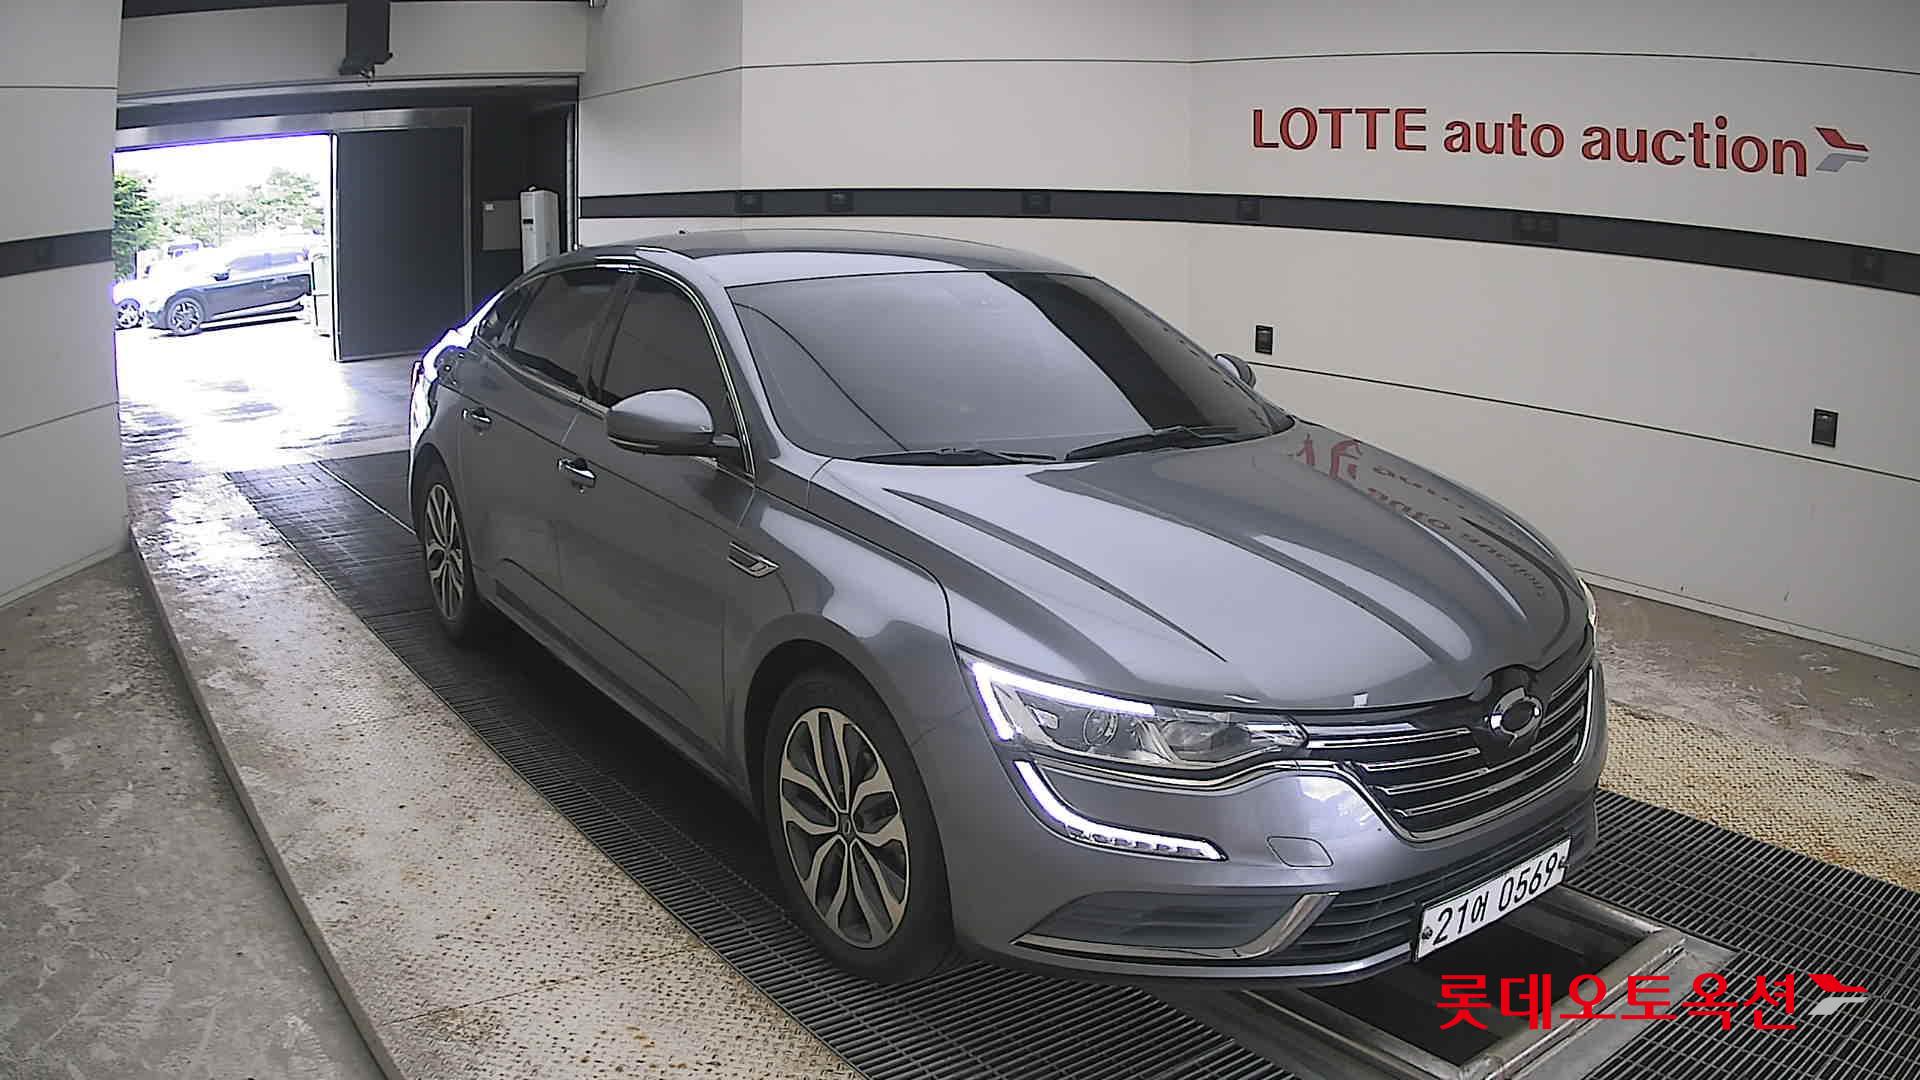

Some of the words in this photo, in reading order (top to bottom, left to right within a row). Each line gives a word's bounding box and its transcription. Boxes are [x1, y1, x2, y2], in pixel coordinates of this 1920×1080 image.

[1253, 108, 1428, 152] LOTTE
[1444, 113, 1565, 159] auto
[1582, 116, 1808, 175] auction
[1432, 891, 1490, 946] 21어
[1498, 852, 1558, 912] 0569
